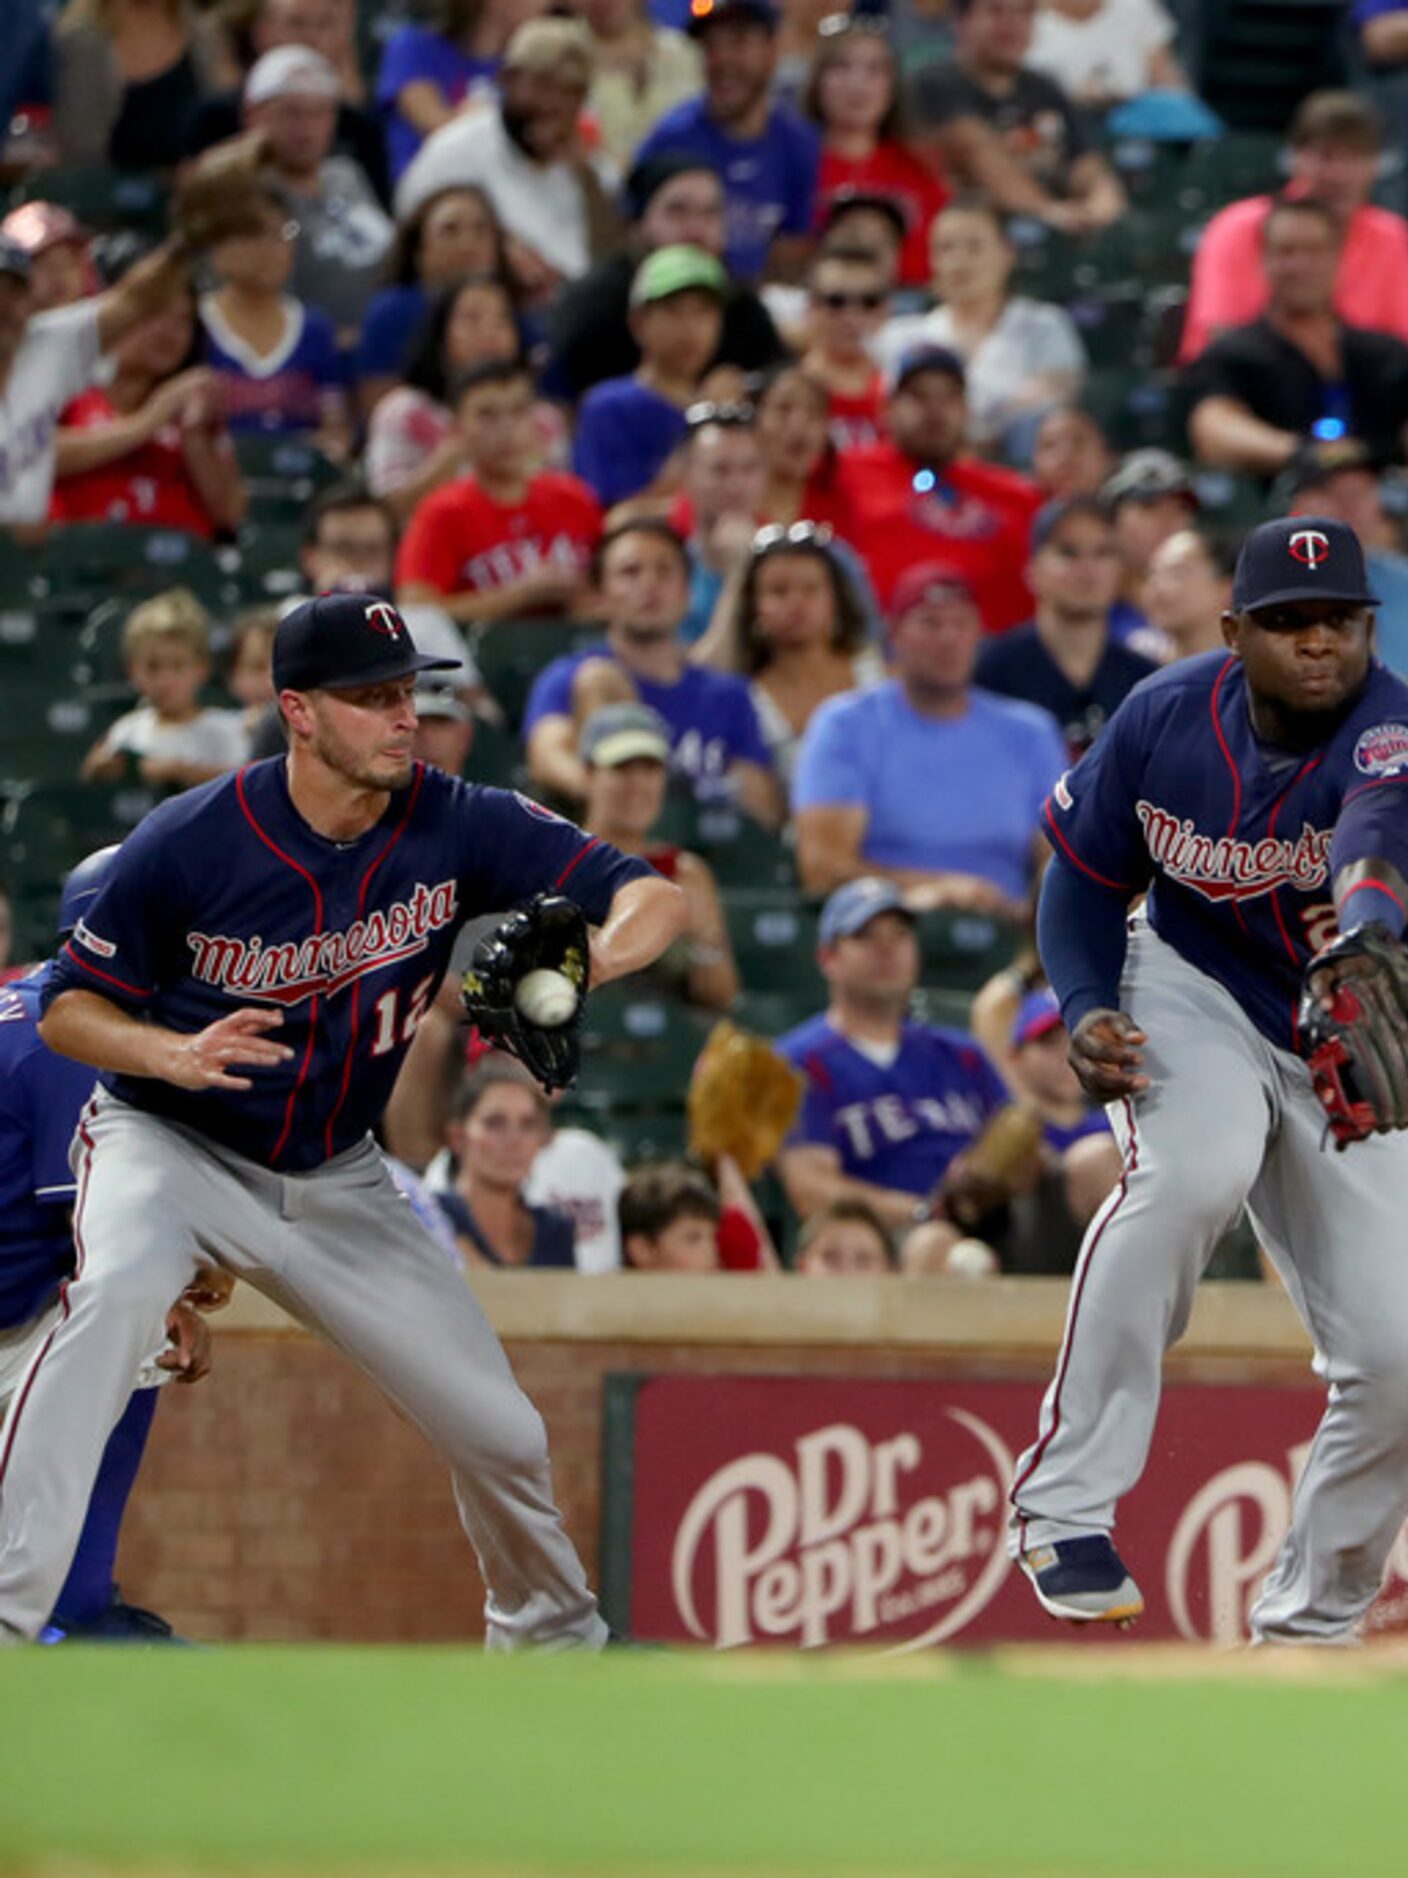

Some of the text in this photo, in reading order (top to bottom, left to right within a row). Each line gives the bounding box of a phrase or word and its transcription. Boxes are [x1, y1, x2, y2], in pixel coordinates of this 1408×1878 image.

[186, 879, 459, 1005] Minnesota
[794, 1422, 922, 1548] Dr
[671, 1452, 1001, 1651] Pepper
